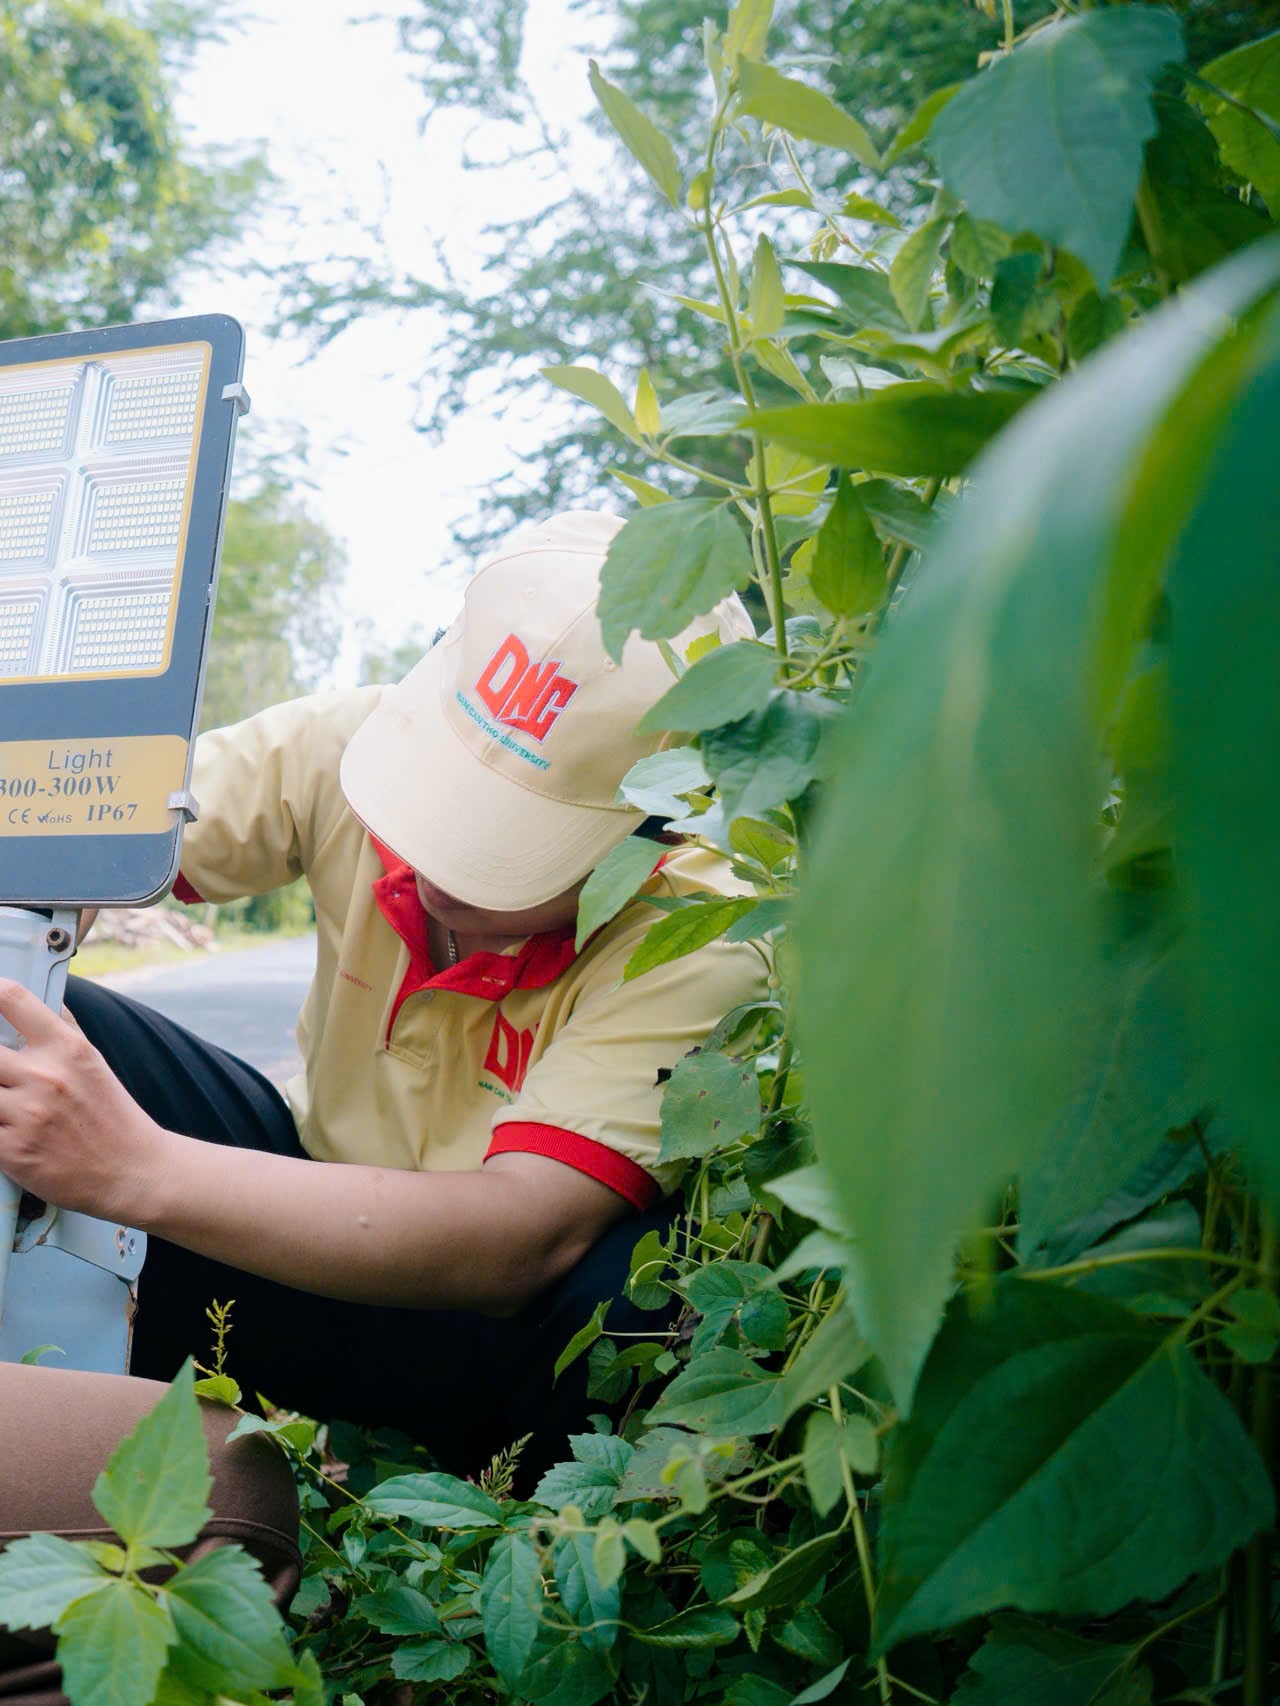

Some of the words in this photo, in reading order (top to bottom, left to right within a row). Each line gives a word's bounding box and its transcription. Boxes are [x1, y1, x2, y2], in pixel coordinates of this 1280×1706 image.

[475, 632, 579, 742] DNC
[48, 749, 113, 774] Light
[88, 804, 138, 821] IP67
